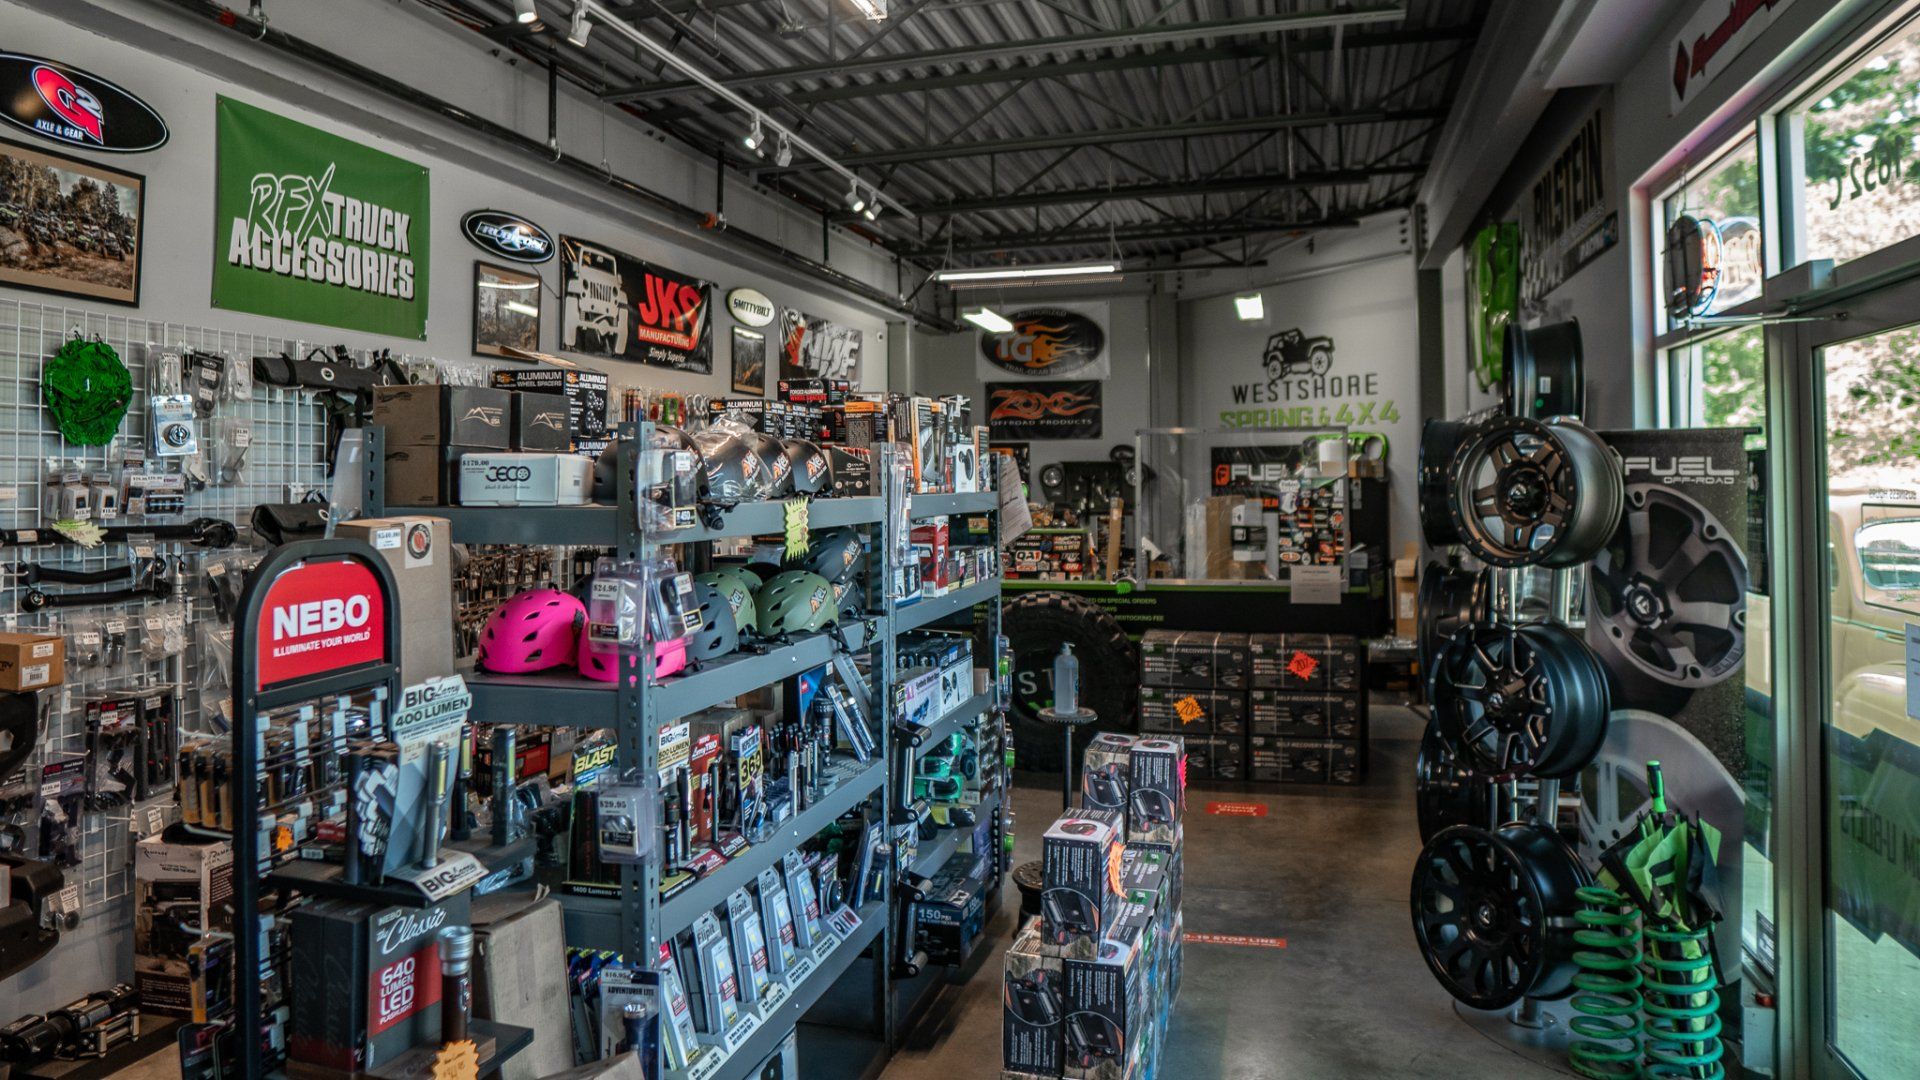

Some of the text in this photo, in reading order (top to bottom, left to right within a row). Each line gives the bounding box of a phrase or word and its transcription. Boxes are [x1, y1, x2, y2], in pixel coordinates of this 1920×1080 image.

[36, 119, 84, 141] AXLE & GEAR
[325, 191, 410, 254] TRUCK
[228, 217, 415, 300] ACCESSORIES
[638, 273, 703, 334] JKS
[733, 298, 771, 318] SMITTYBILT
[639, 327, 690, 348] MANUFACTURING
[517, 371, 562, 380] ALUMINUM
[537, 380, 562, 388] SPACERS
[580, 373, 607, 384] ALUMINUM
[1233, 373, 1379, 405] WESTSHORE
[1040, 418, 1093, 427] PRODUCTS
[1219, 405, 1314, 430] SPRING
[1335, 400, 1401, 426] 4X4
[1625, 456, 1734, 476] FUEL
[1663, 476, 1735, 485] OFF-ROAD
[273, 595, 371, 641] NEBO
[273, 631, 371, 658] ILLUMINATE YOUR WORLD
[405, 687, 435, 708] BIG
[395, 710, 423, 727] 400
[425, 697, 469, 719] LUMEN
[660, 733, 673, 747] BIG
[574, 744, 618, 774] BLAST
[421, 872, 452, 893] BIG
[573, 886, 612, 896] 1400 Lumens
[378, 909, 402, 926] NEBO
[919, 908, 941, 919] 150
[381, 908, 447, 955] Classic
[380, 957, 416, 986] 640
[380, 972, 415, 998] LUMEN
[608, 986, 655, 996] ADVENTURER LITE
[380, 985, 415, 1016] LED
[379, 1002, 414, 1025] FLASHLIGHT
